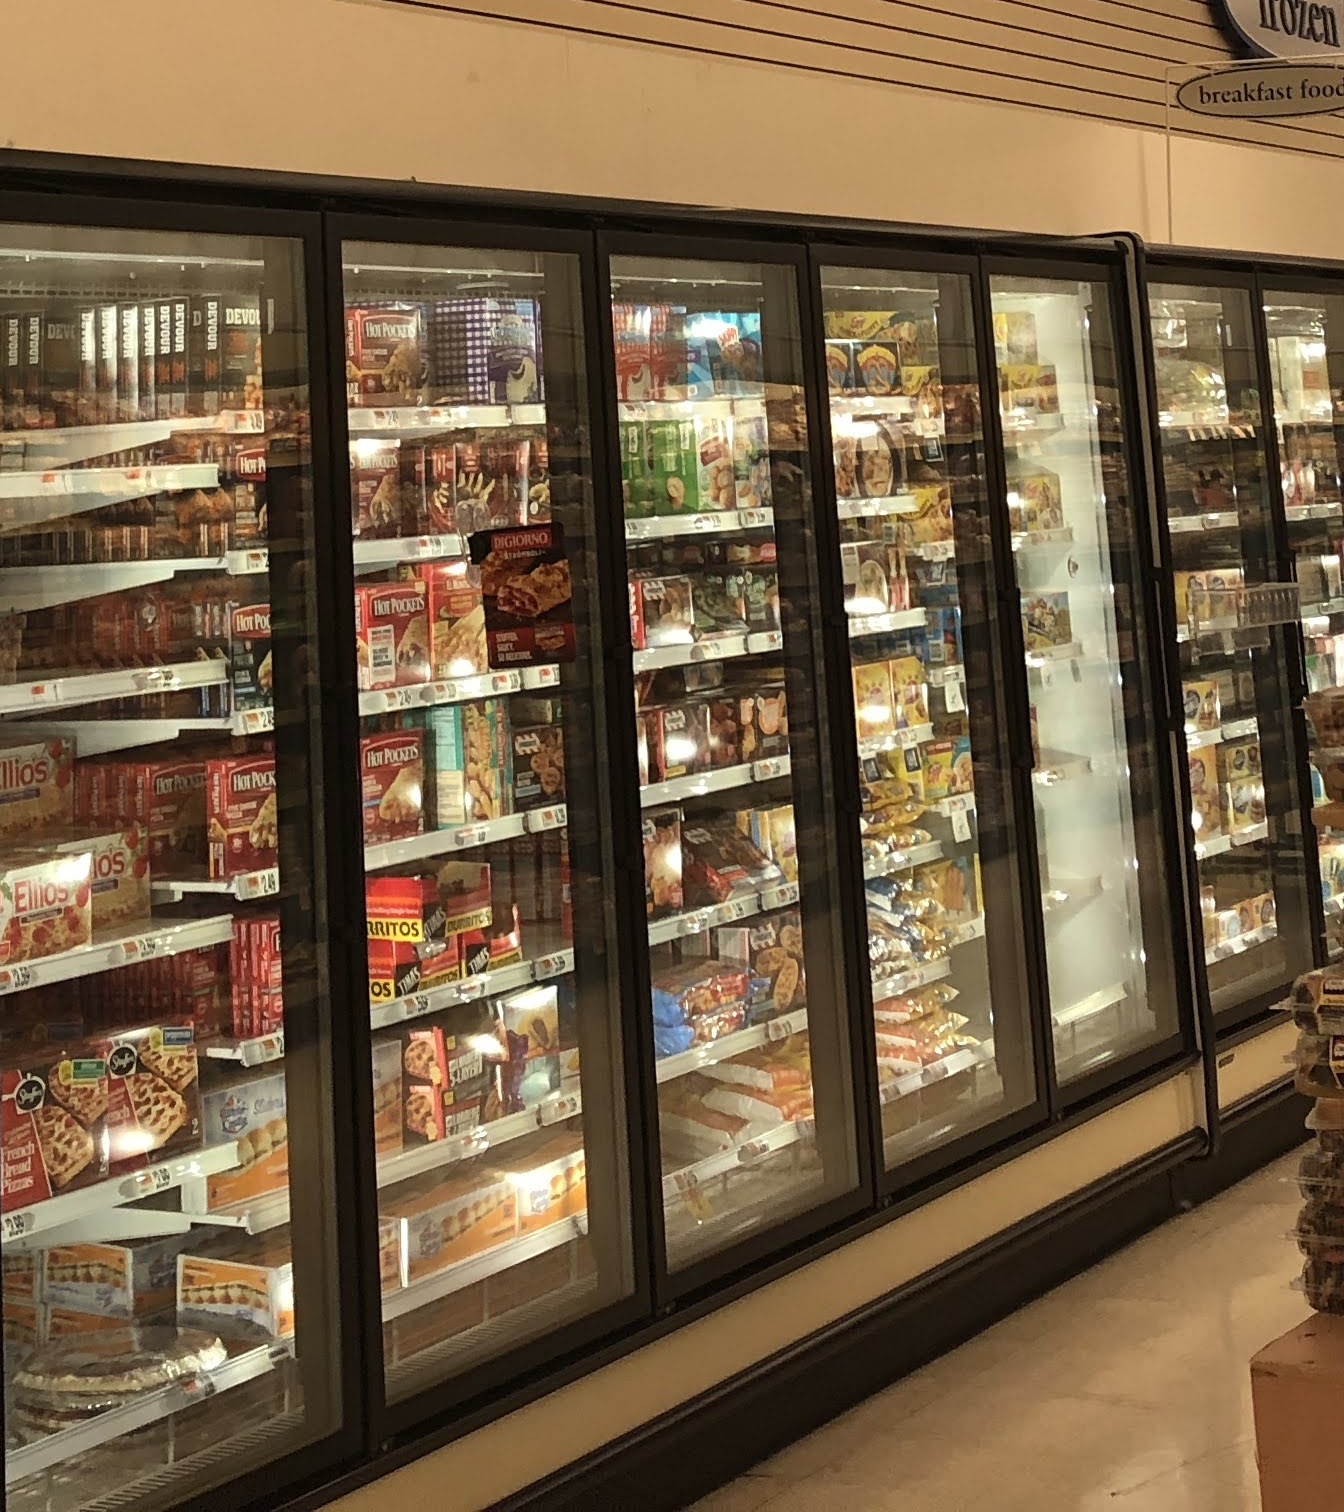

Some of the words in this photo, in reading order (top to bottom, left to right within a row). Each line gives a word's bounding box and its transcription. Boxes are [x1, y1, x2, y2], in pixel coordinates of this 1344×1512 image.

[1198, 81, 1293, 108] breakfast
[160, 305, 171, 355] DEVOUR
[175, 303, 185, 353] DEVOUR
[207, 301, 218, 351] DEVOUR
[366, 322, 382, 339] HOT
[382, 320, 417, 339] POCKETS
[8, 319, 19, 367] DEVOUR
[29, 317, 40, 365] DEVOUR
[240, 457, 257, 474] HOT
[494, 532, 548, 548] DIGIORNO
[375, 599, 390, 616] HOT
[391, 595, 425, 614] POCKETS
[236, 614, 254, 632] HOT
[367, 751, 384, 769] HOT
[385, 744, 419, 764] POCKETS
[233, 773, 251, 791] HOT
